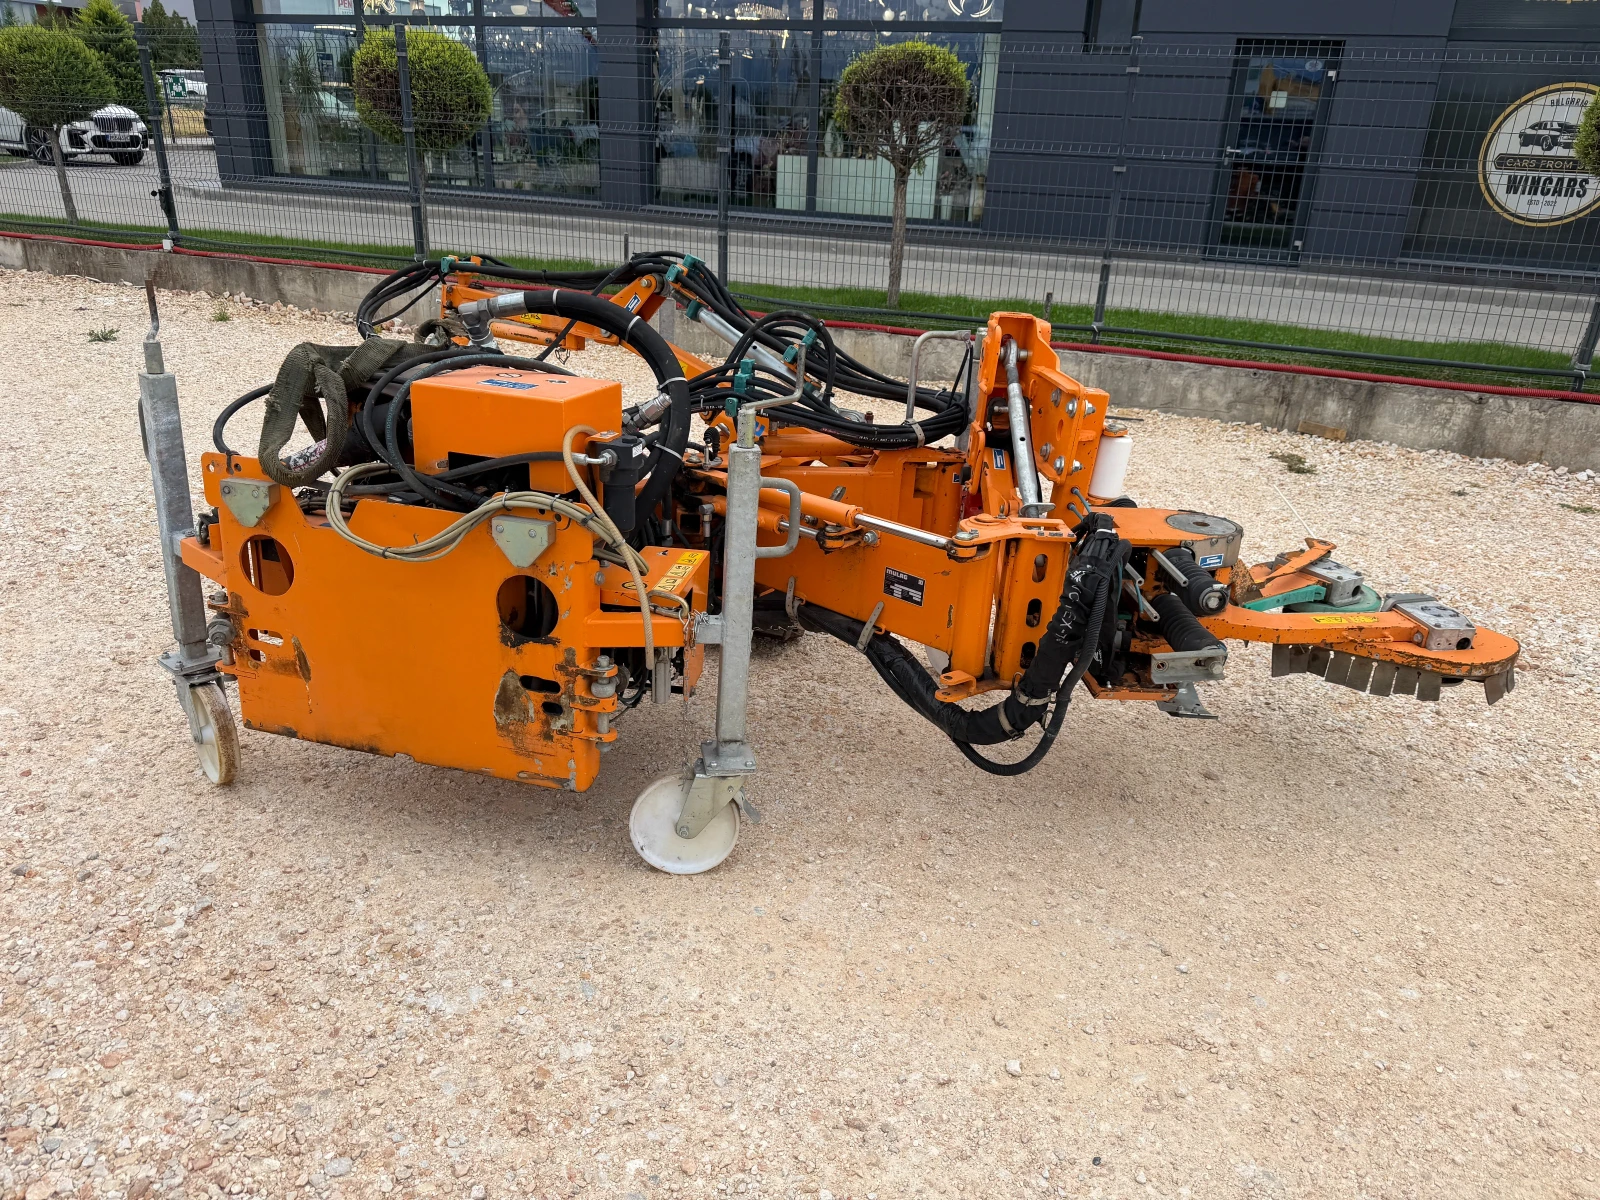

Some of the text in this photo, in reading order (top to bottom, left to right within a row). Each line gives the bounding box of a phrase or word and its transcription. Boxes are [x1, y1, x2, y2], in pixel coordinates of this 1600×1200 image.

[1506, 158, 1536, 168] CARS
[1539, 160, 1573, 169] FROM
[1505, 174, 1590, 198] WINCARS
